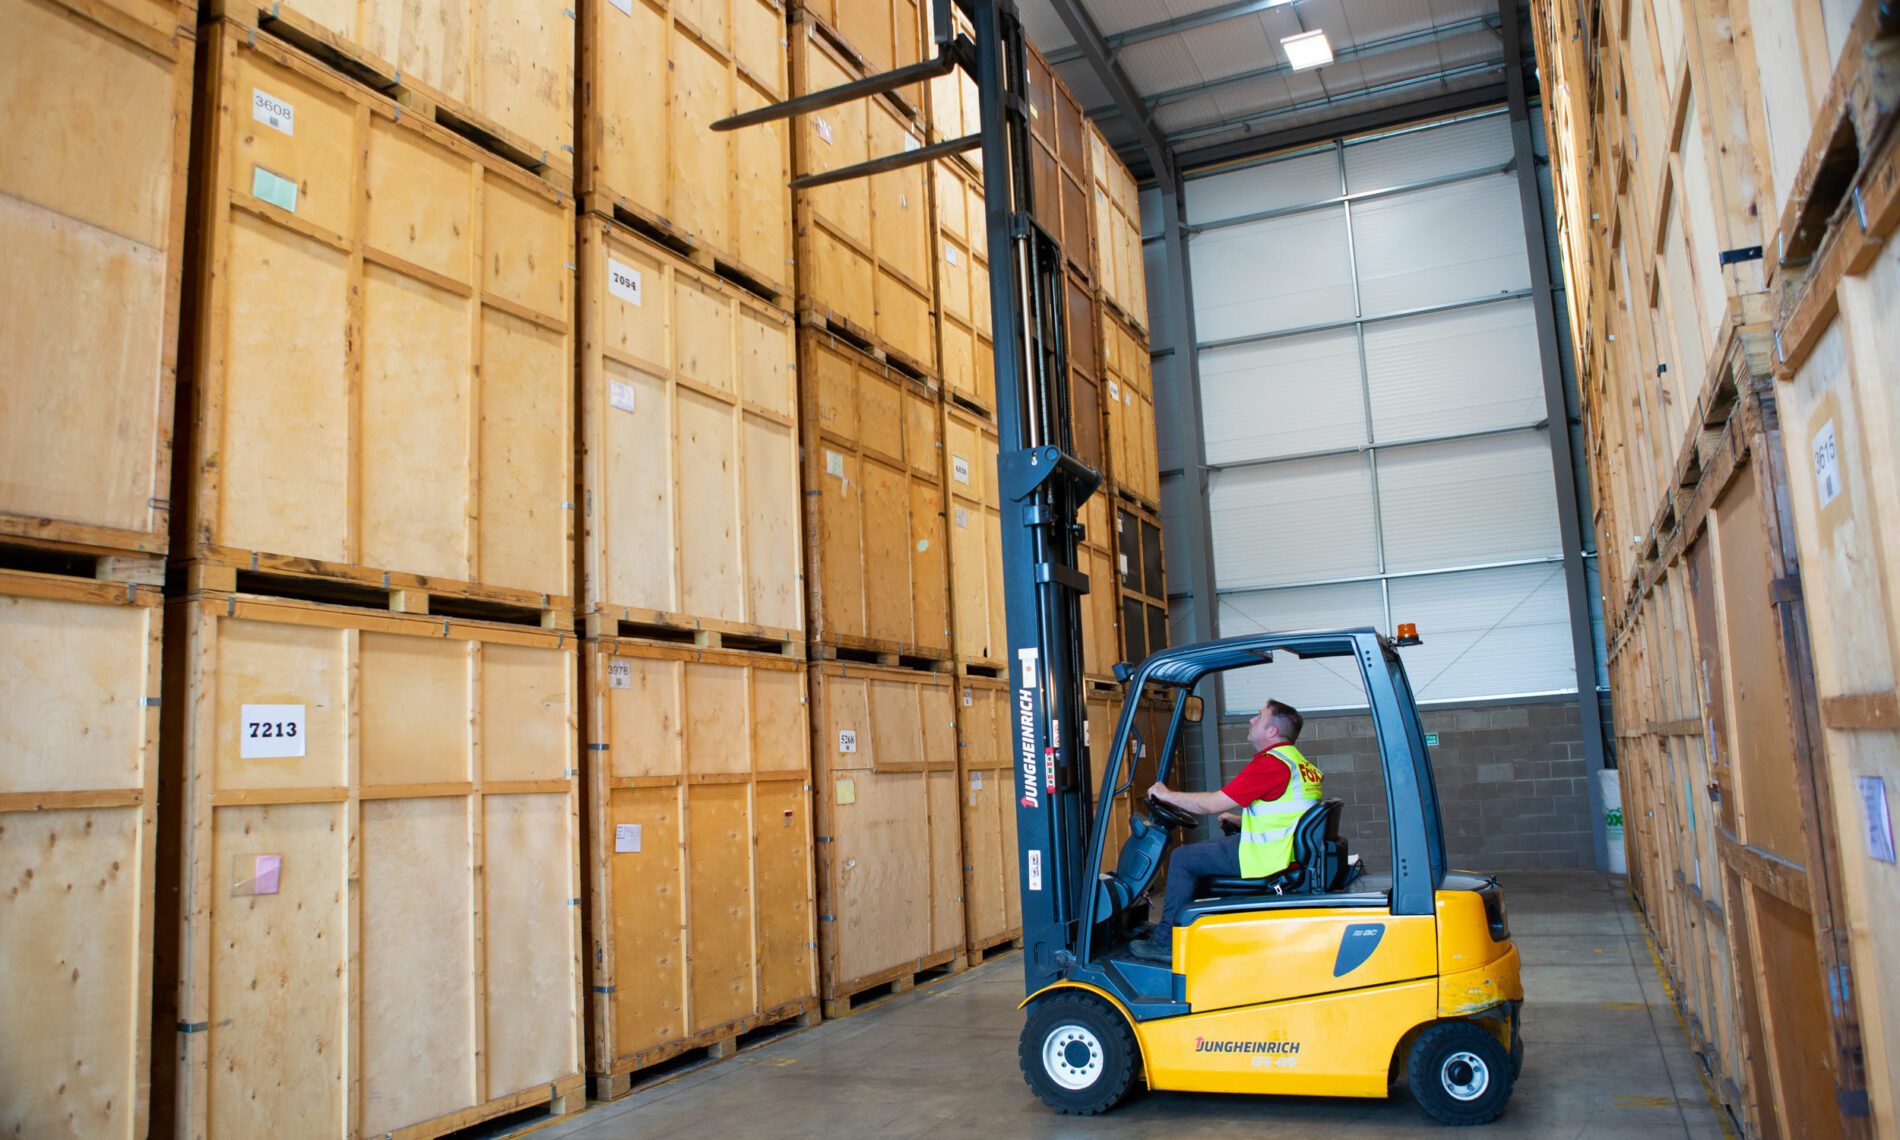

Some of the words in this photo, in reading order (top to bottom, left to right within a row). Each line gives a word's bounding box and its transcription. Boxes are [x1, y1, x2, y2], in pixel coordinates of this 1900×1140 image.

[255, 95, 292, 120] 3608
[613, 272, 637, 292] 7054
[1815, 434, 1836, 475] 3615
[608, 665, 629, 676] 3976
[249, 722, 298, 738] 7213
[1019, 689, 1039, 808] JUNGHEINRICH
[1196, 1040, 1300, 1054] JUNGHEINRICH
